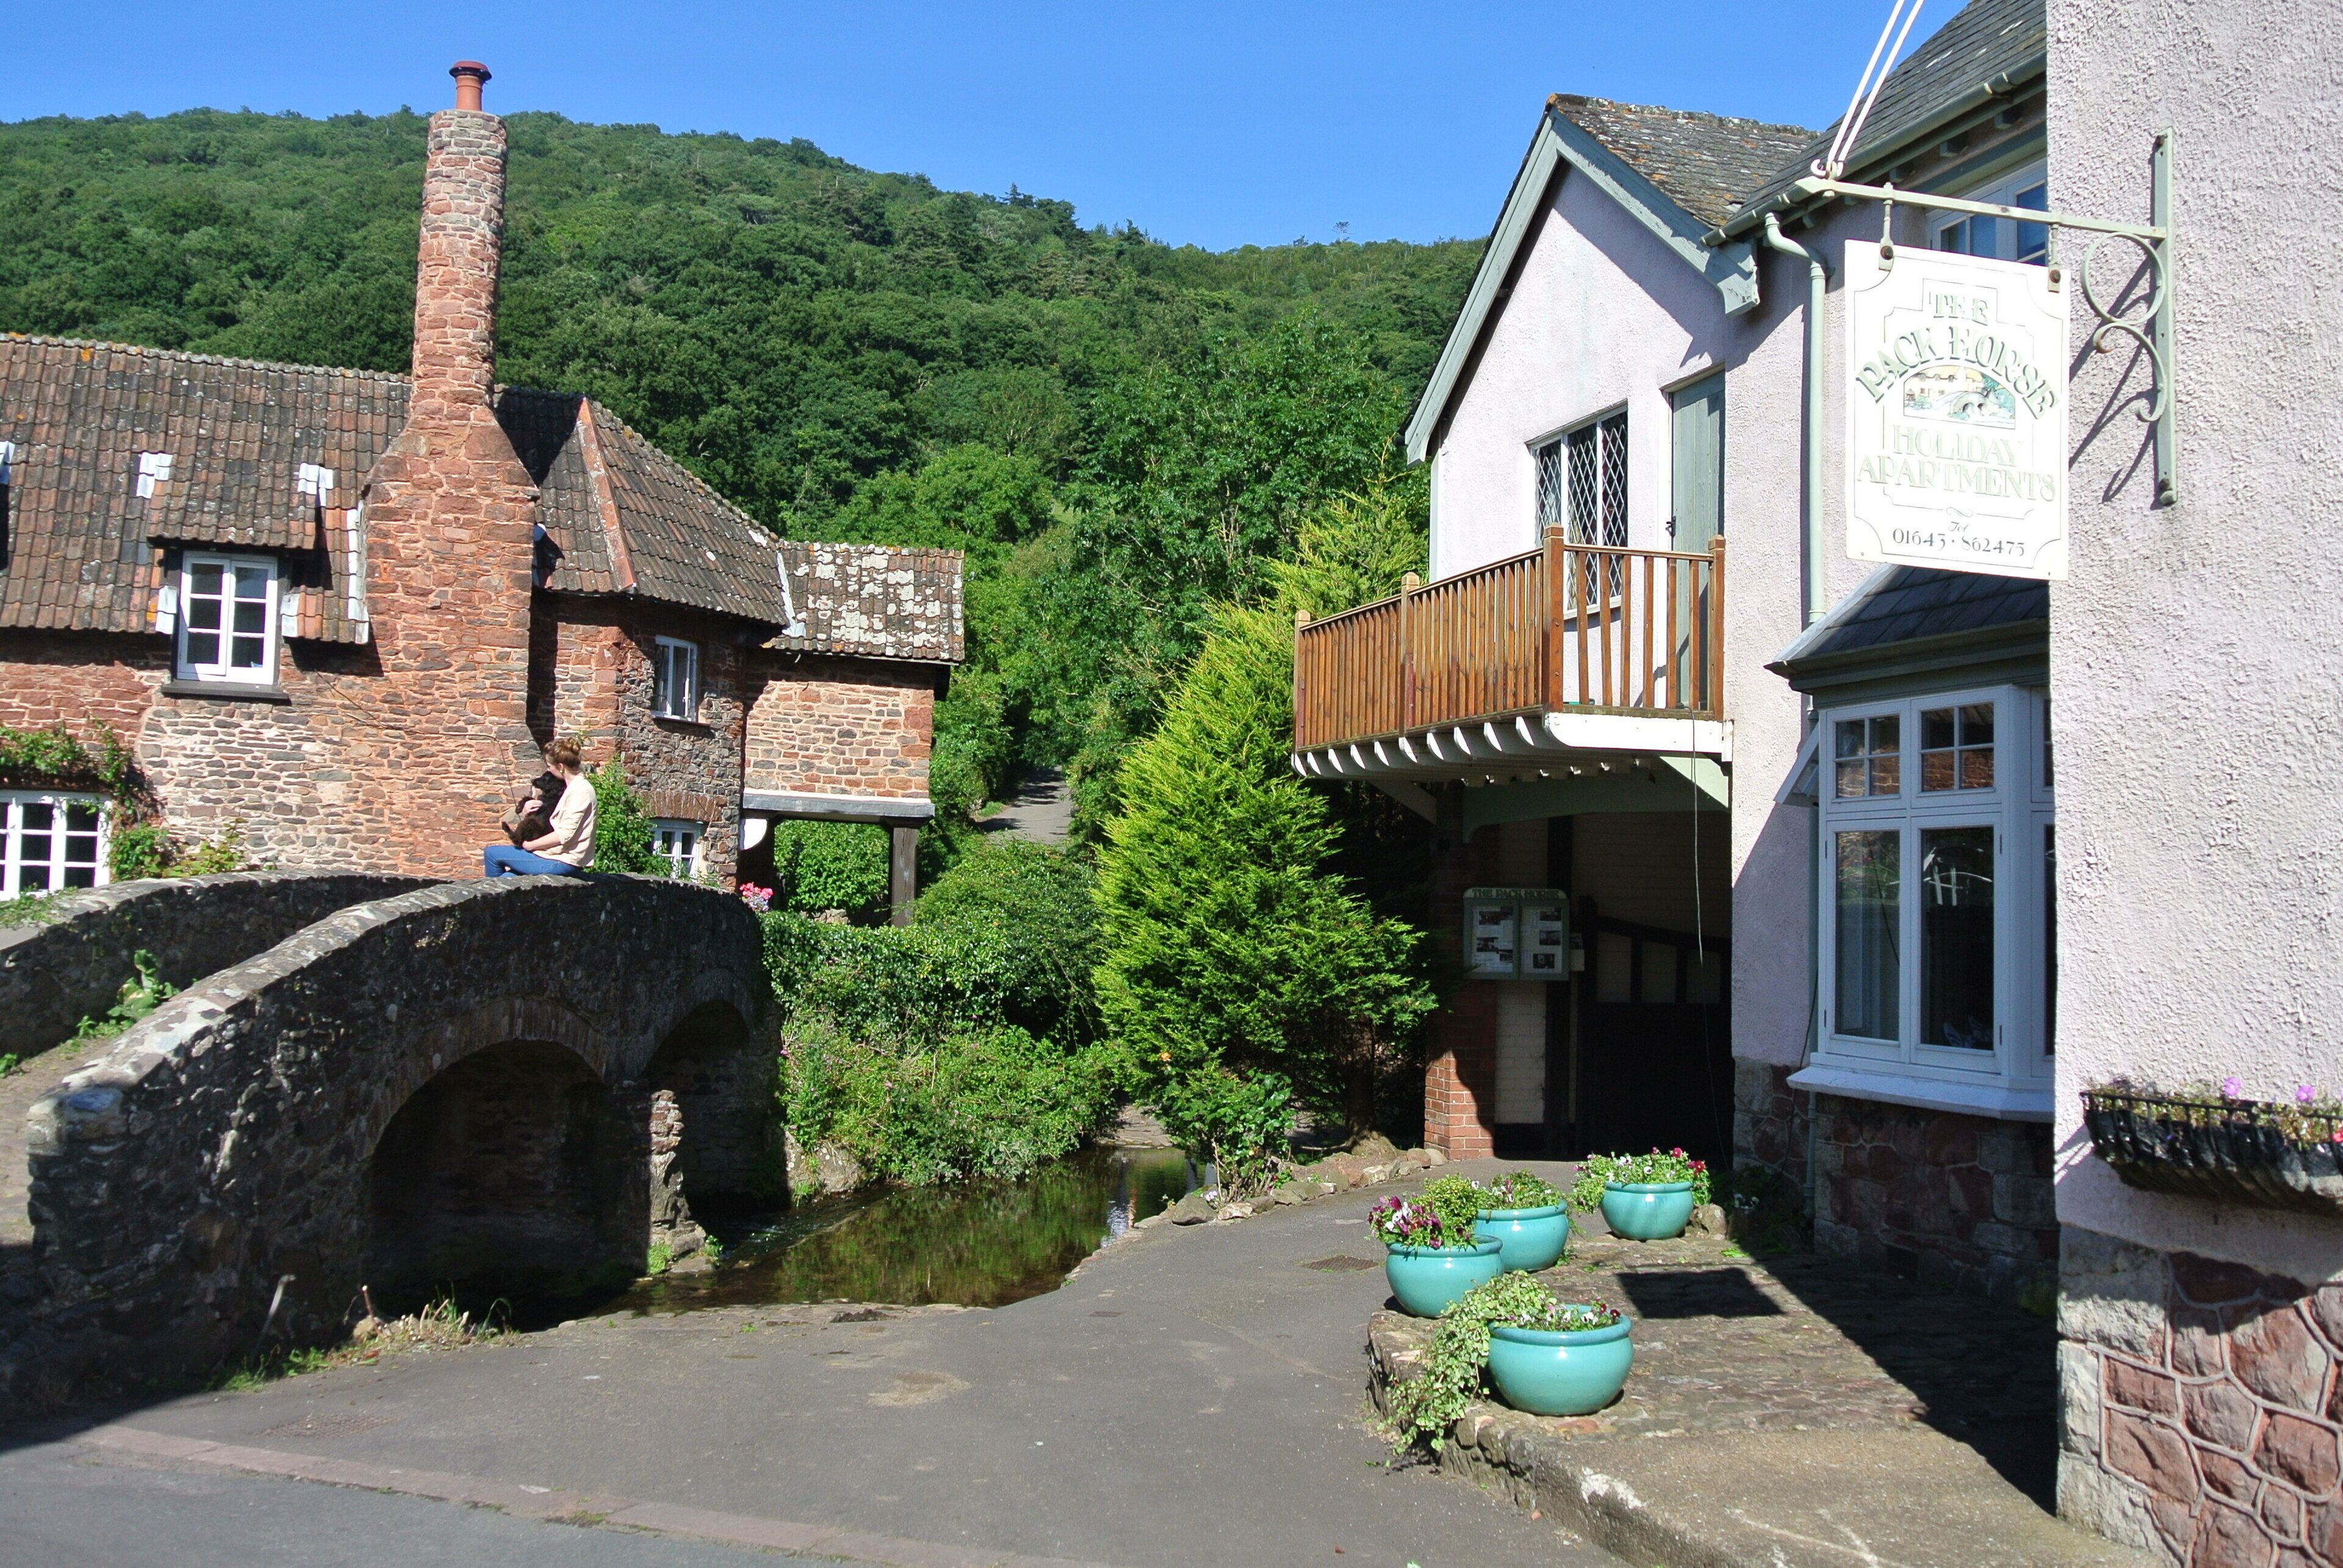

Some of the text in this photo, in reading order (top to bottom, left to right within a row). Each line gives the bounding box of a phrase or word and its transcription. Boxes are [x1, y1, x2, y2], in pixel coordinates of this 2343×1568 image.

[1929, 291, 1990, 326] THE
[1855, 326, 2060, 420] PACK HORSE
[1892, 424, 2024, 467] HOLIDAY
[1857, 455, 2057, 502] APARTMENTS
[1892, 528, 2025, 557] 01643 862475
[1948, 521, 1970, 533] Tel
[1472, 889, 1560, 899] THE PACK HORSE
